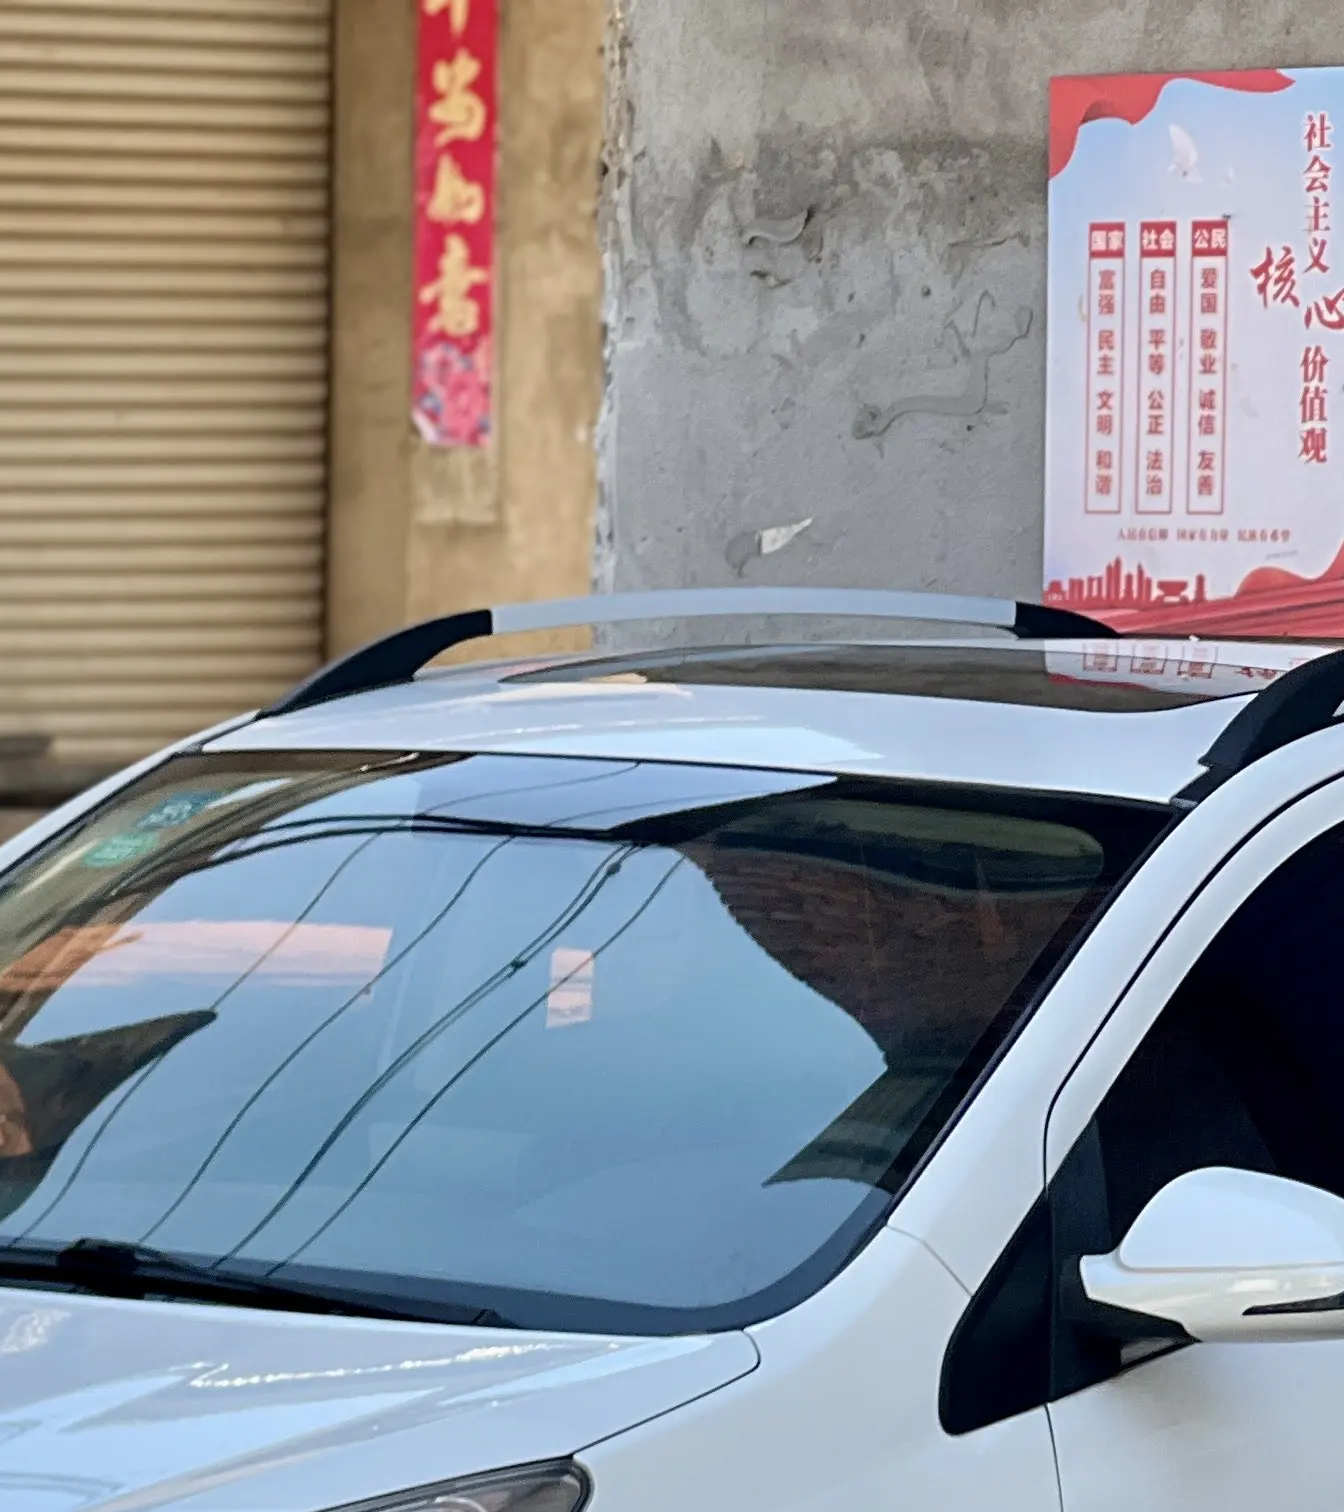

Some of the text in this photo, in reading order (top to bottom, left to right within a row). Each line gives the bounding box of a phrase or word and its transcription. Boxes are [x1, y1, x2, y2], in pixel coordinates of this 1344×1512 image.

[1302, 112, 1332, 274] 社会主义
[1090, 229, 1124, 251] 国家
[1142, 227, 1174, 250] 社会
[1194, 227, 1226, 249] 公民
[1200, 267, 1218, 314] 爱国
[1097, 329, 1115, 375] 民主
[1146, 268, 1166, 495] 自由 平等 公正 法治
[1298, 345, 1329, 464] 价值观
[1096, 389, 1114, 435] 文明
[1198, 389, 1216, 436] 诚信
[1197, 449, 1215, 496] 友善
